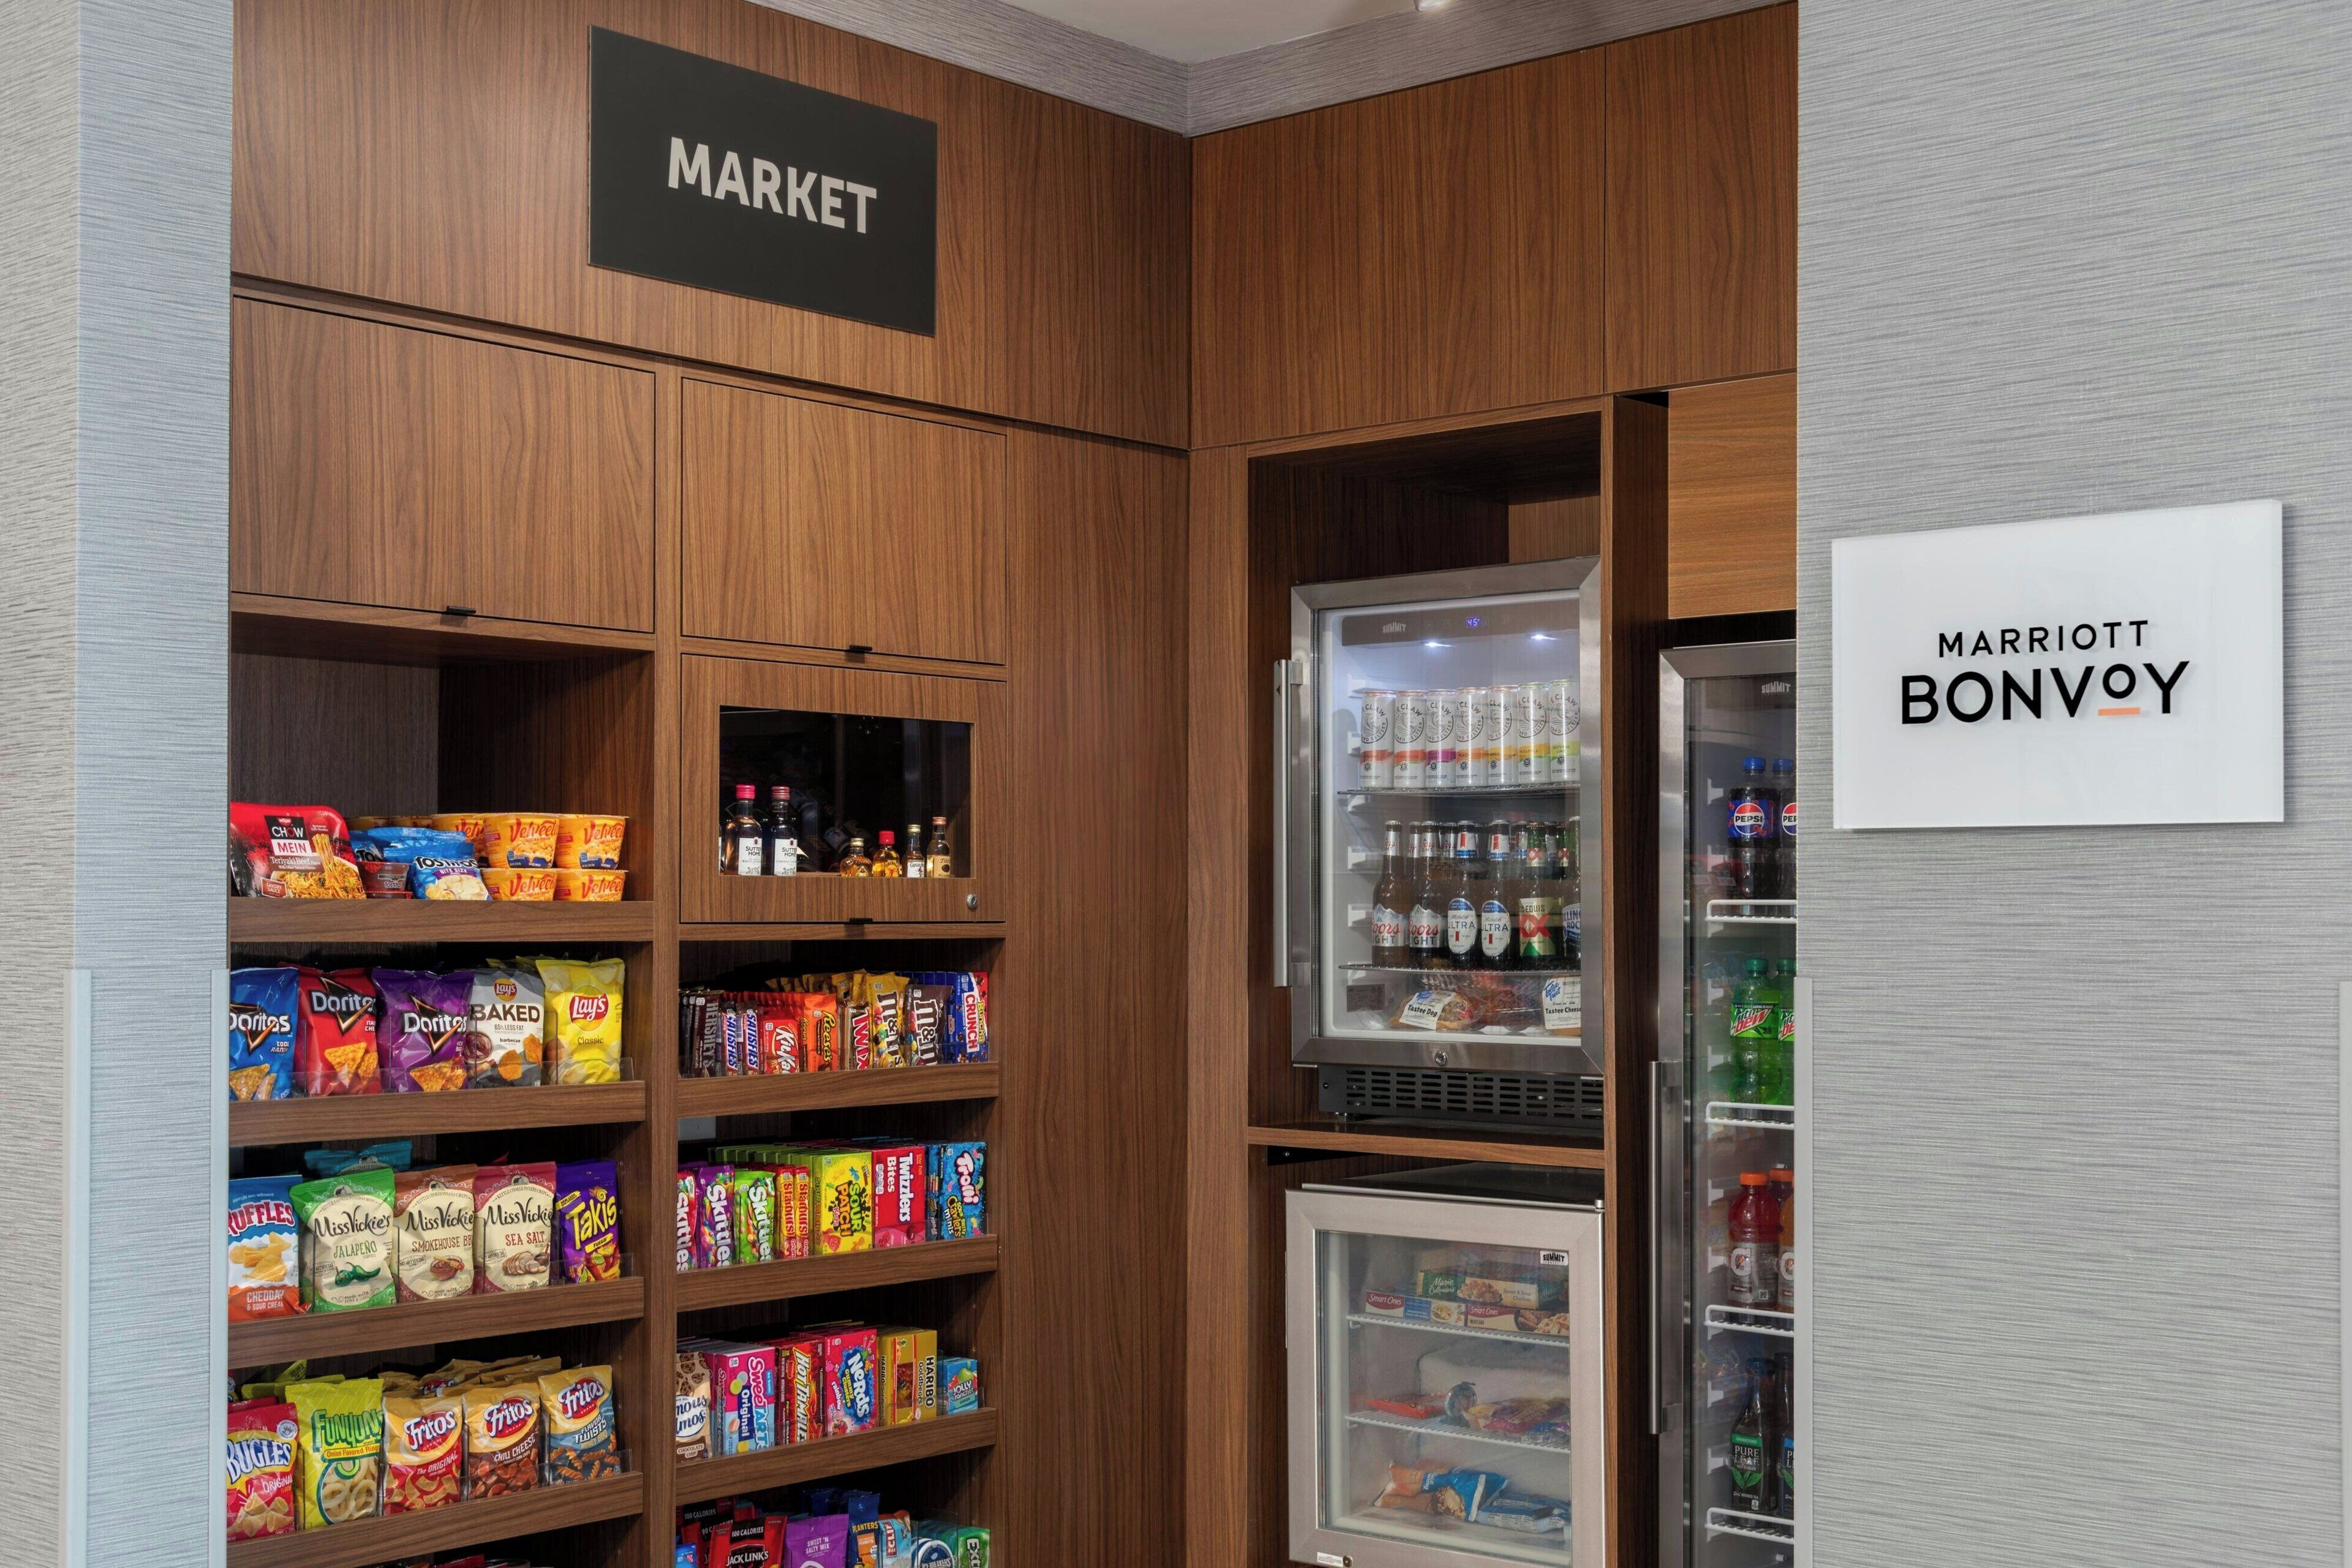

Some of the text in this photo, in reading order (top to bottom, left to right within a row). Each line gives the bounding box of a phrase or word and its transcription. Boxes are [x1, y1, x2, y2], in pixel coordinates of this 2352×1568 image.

[668, 137, 876, 234] MARKET
[1382, 622, 1407, 633] SUMMIT
[1939, 620, 2148, 658] MARRIOTT
[1762, 681, 1791, 694] SUMMIT
[1902, 661, 2189, 724] BONVOY
[272, 826, 304, 838] CHOW
[277, 842, 307, 854] MEIN
[496, 983, 516, 996] Lay's
[470, 1004, 540, 1023] BAKED
[572, 995, 608, 1022] Lay's
[1408, 1005, 1438, 1017] Tastee Dog
[965, 994, 978, 1049] CRUNCH
[577, 1037, 604, 1046] Classic
[747, 1013, 758, 1068] SATISFIES
[887, 1156, 897, 1193] Bites
[956, 1152, 979, 1204] Trolli
[899, 1152, 914, 1223] Twizzlers
[484, 1204, 520, 1226] Miss
[565, 1189, 617, 1250] Takis
[783, 1182, 796, 1237] Starburst
[799, 1182, 808, 1237] Starburst
[835, 1182, 853, 1237] PATCH
[849, 1182, 862, 1232] SOUR
[948, 1196, 961, 1237] Crawlers
[313, 1205, 390, 1237] Miss Vickie's
[405, 1210, 439, 1231] Miss
[677, 1192, 692, 1272] Skittles
[707, 1184, 732, 1267] Skittles
[748, 1186, 772, 1262] Skittles
[944, 1208, 954, 1235] minis
[334, 1240, 377, 1259] JALAPEÑO
[412, 1236, 460, 1253] SMOKEHOUSE
[505, 1231, 545, 1246] SEA SALT
[594, 1237, 607, 1248] FUEGO
[1542, 1252, 1565, 1262] SUMMIT
[1430, 1277, 1454, 1286] Marie
[247, 1288, 284, 1303] CHEDDAR
[252, 1302, 266, 1311] SOUR
[1368, 1293, 1401, 1305] Smart Ones
[925, 1355, 935, 1408] HARIBO
[953, 1380, 971, 1396] JOLLY
[558, 1380, 605, 1419] Fritos
[831, 1381, 842, 1411] rainbow
[483, 1399, 533, 1438] Fritos
[581, 1414, 601, 1434] FLAVOR
[740, 1389, 752, 1437] Original
[404, 1410, 456, 1451] Fritos
[573, 1417, 607, 1444] TWISTS
[494, 1434, 536, 1462] CHILI CHEESE
[677, 1444, 704, 1453] CHOCOLATE
[1735, 1446, 1760, 1457] PURE
[227, 1439, 292, 1484] BUGLES
[428, 1450, 458, 1473] ORIGINAL
[693, 1509, 717, 1518] CALORIES
[741, 1526, 764, 1536] CALORIES
[852, 1521, 879, 1534] PLANTERS
[884, 1521, 895, 1548] CLIF
[805, 1545, 820, 1555] SALTY
[807, 1537, 821, 1547] SWEET
[726, 1554, 744, 1567] JACK
